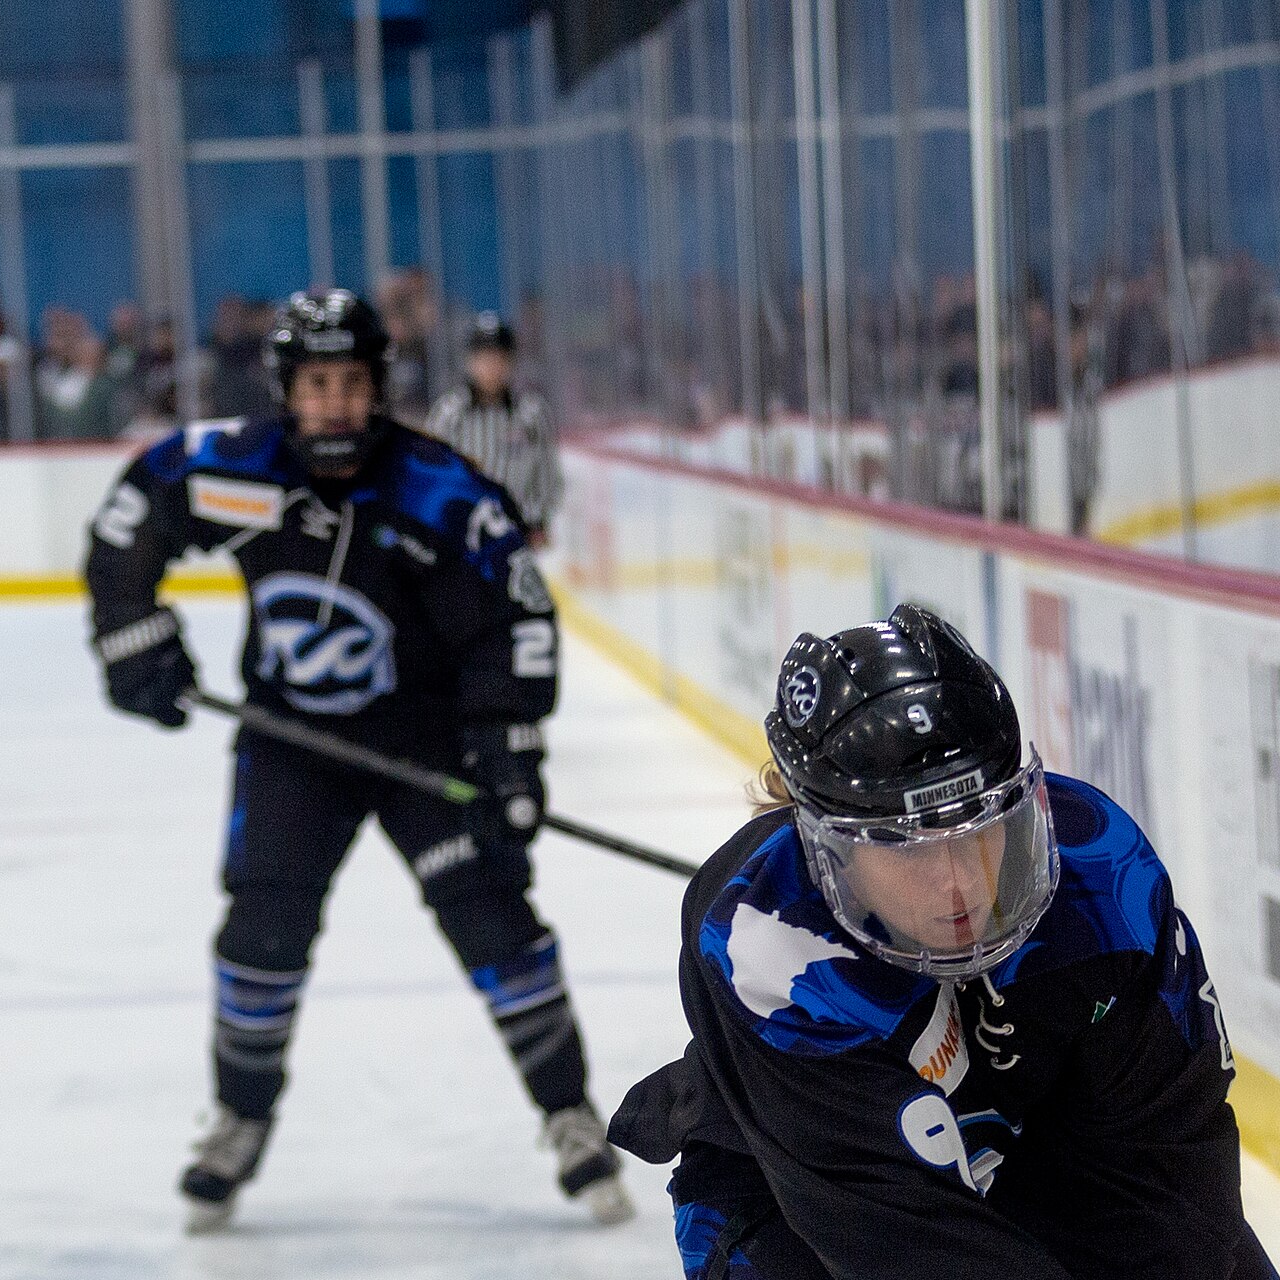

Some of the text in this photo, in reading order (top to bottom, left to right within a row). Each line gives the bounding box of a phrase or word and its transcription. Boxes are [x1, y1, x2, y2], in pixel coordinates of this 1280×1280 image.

[511, 617, 555, 679] 2
[907, 704, 933, 734] 9
[910, 775, 979, 810] MINNESOTA
[896, 1090, 979, 1193] 9
